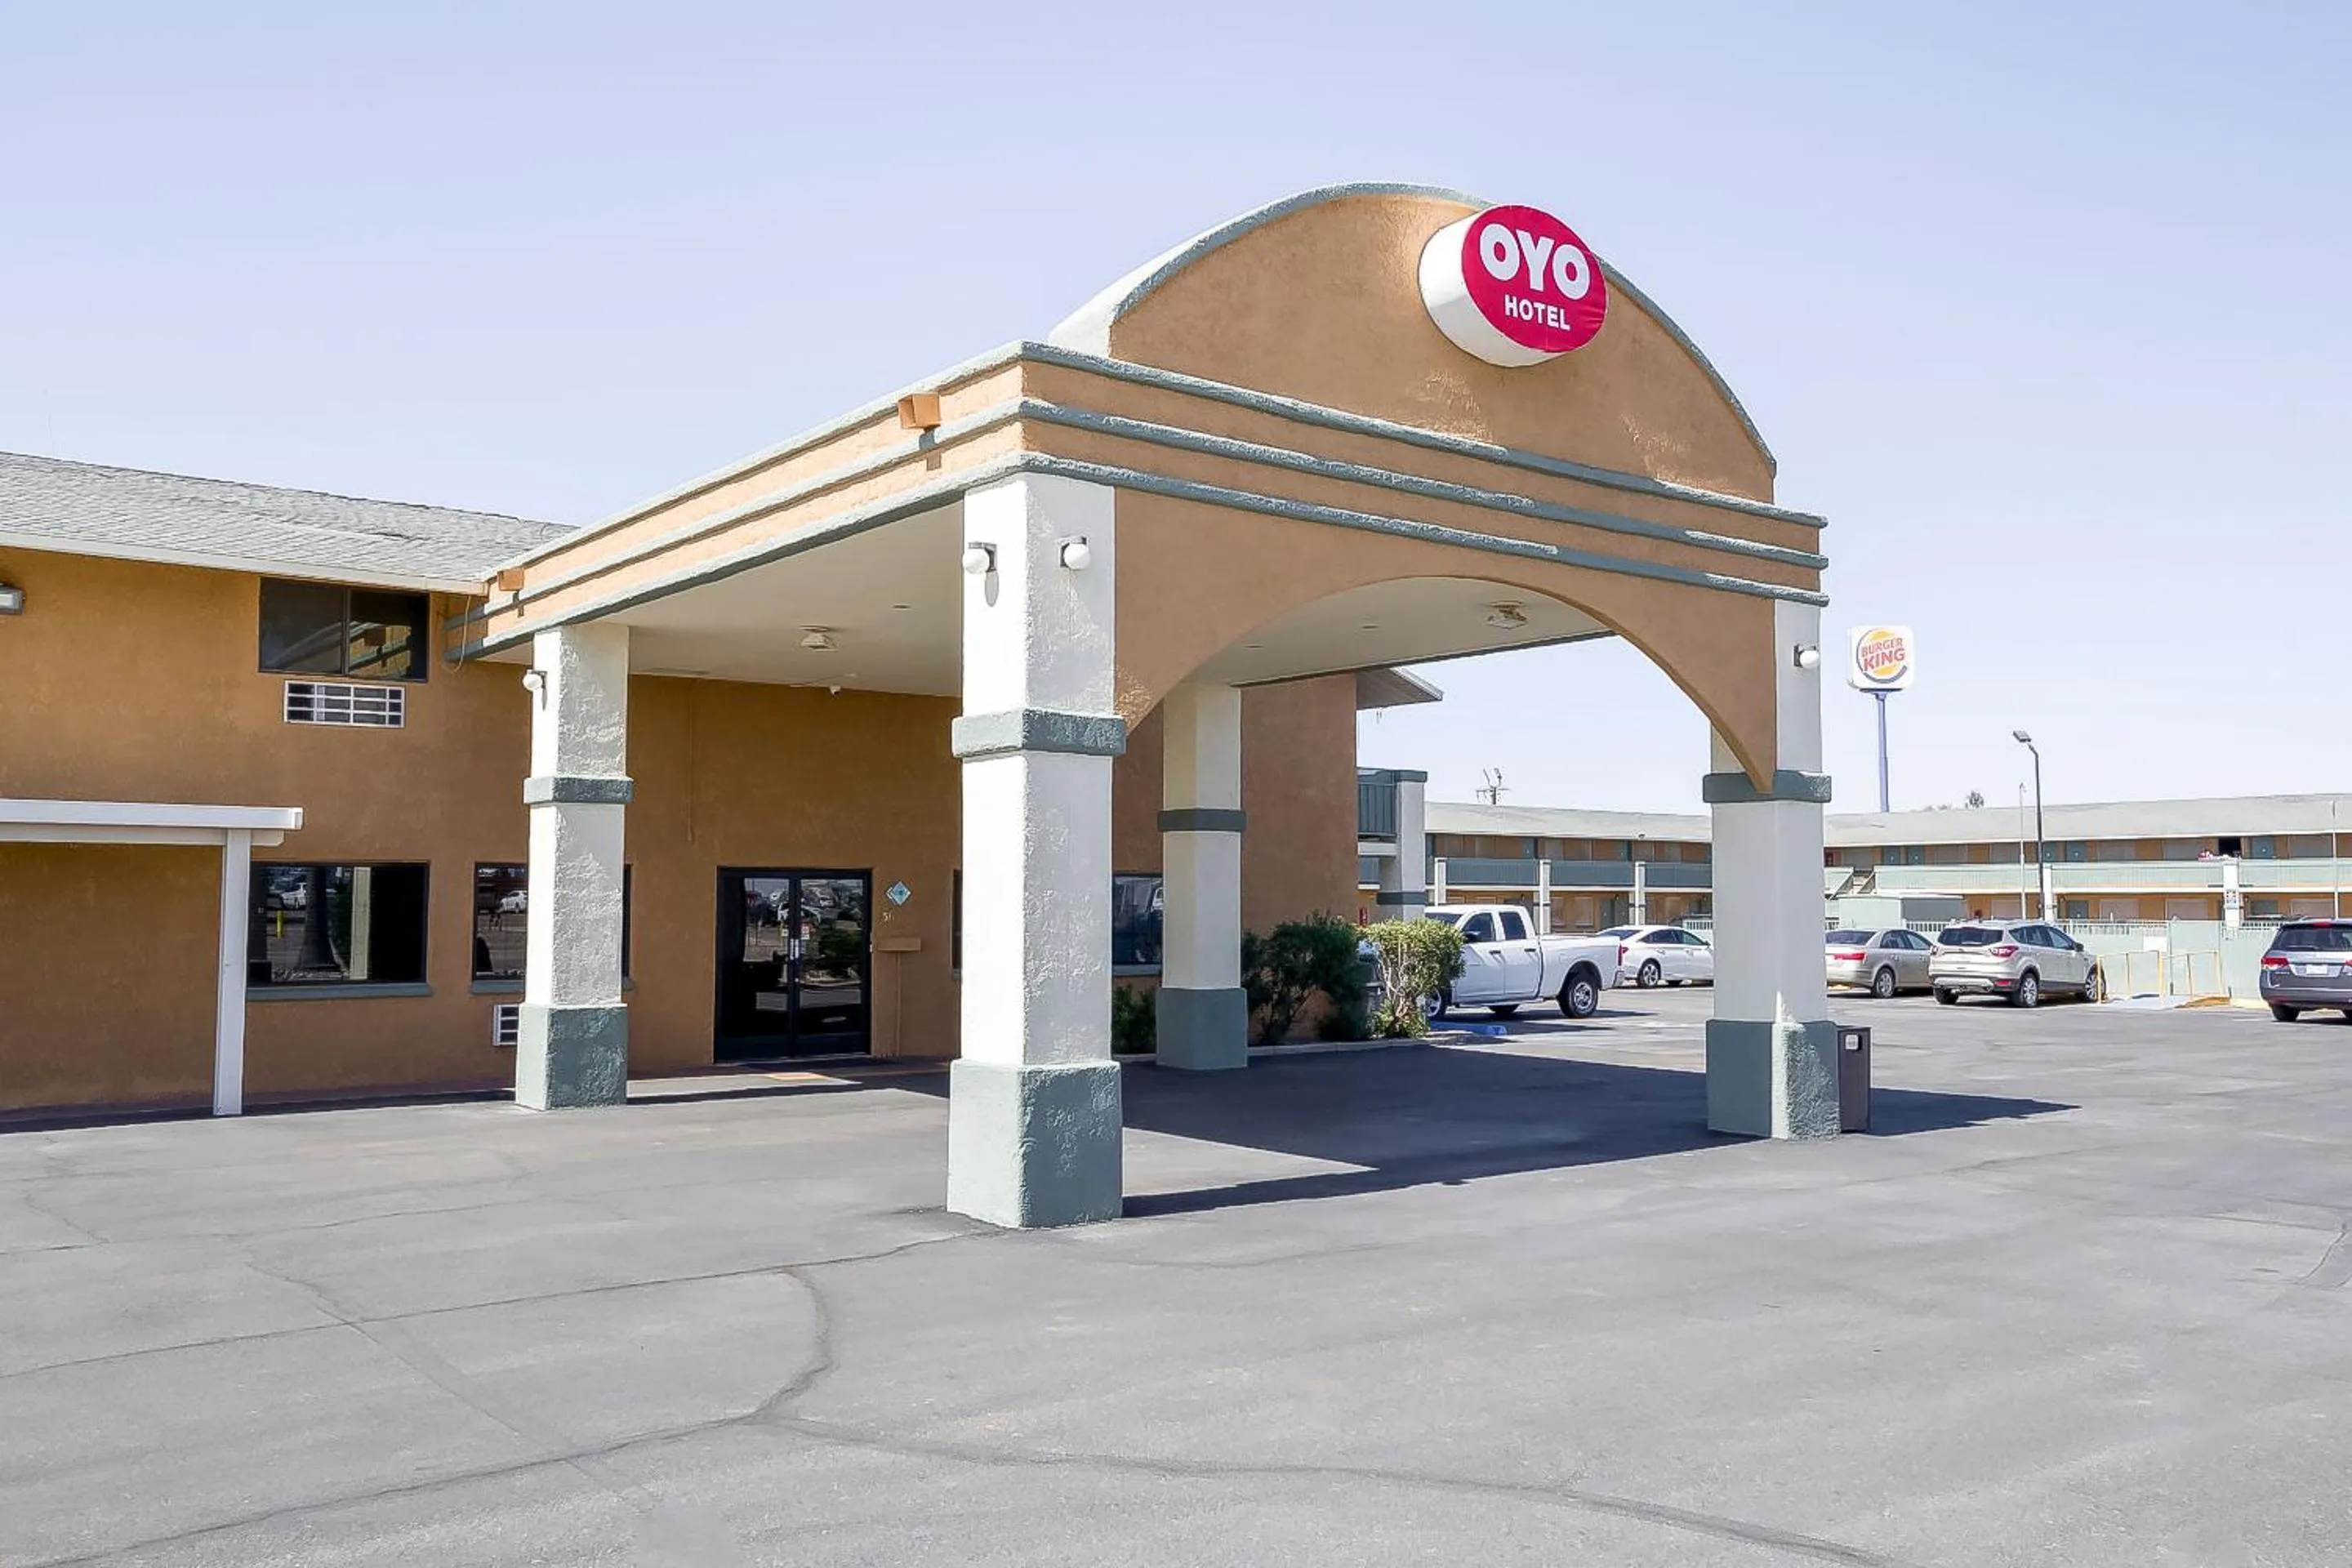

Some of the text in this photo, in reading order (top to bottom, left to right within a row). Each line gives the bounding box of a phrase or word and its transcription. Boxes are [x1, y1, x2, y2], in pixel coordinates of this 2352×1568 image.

[1479, 223, 1591, 301] OYO
[1504, 294, 1570, 331] HOTEL
[1861, 637, 1904, 657] BURGER
[1864, 648, 1905, 671] KING
